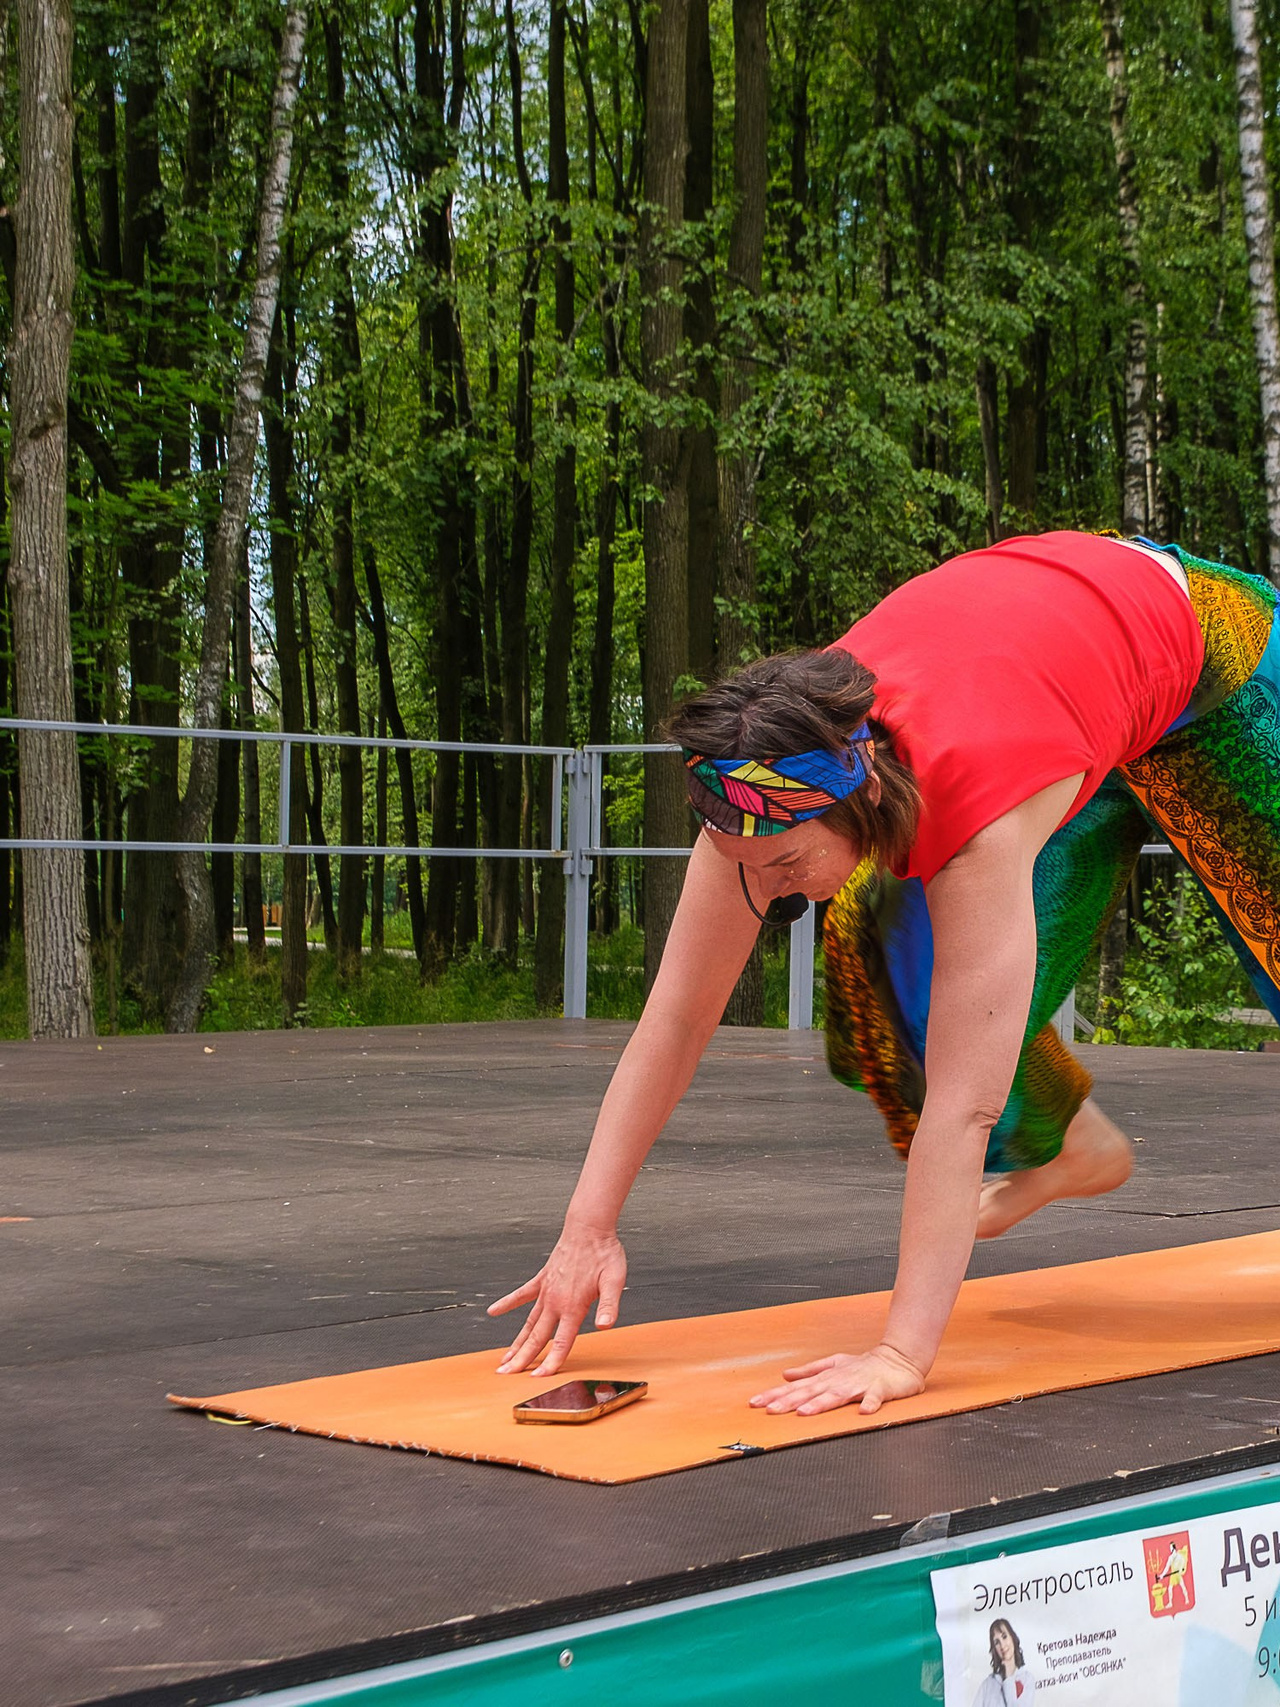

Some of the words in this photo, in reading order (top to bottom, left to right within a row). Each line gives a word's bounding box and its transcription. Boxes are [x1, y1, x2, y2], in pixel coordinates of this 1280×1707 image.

[973, 1560, 1134, 1612] Электросталь
[1244, 1595, 1257, 1627] 5
[1037, 1637, 1074, 1656] Кретова
[1075, 1627, 1117, 1648] Надежда
[1046, 1646, 1112, 1670] Преподаватель
